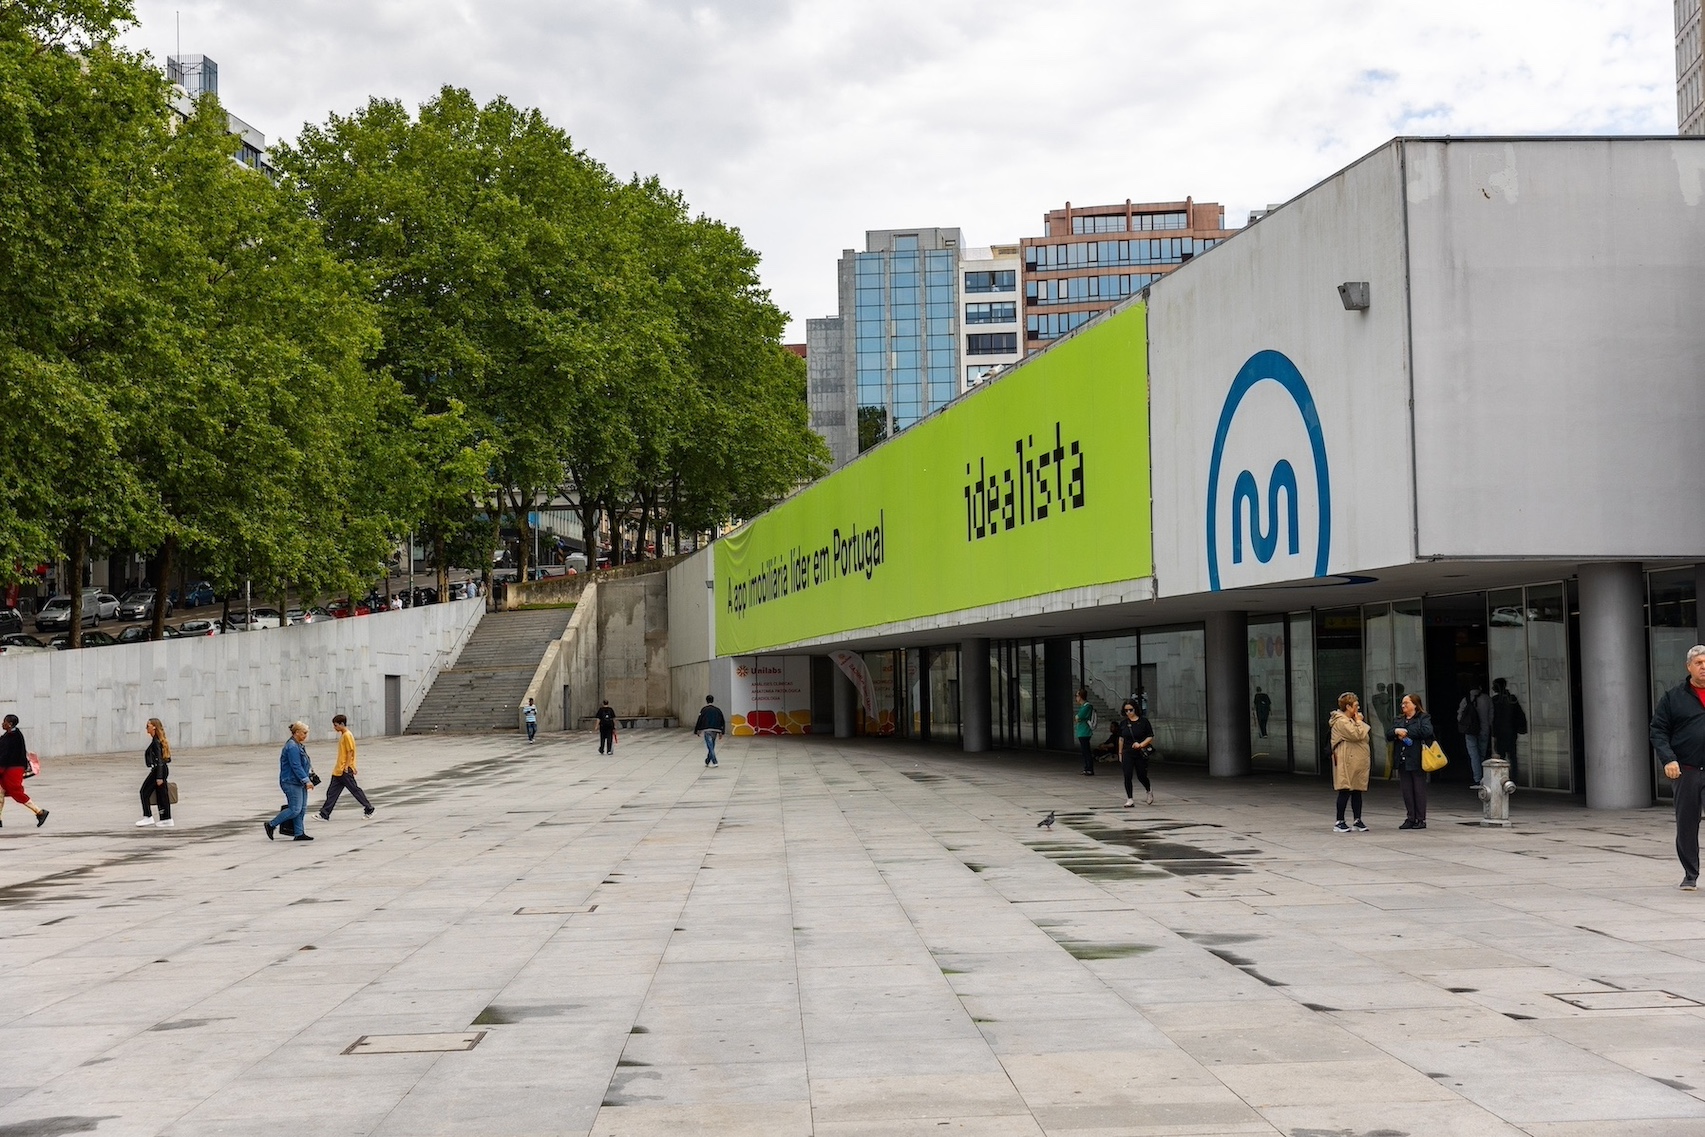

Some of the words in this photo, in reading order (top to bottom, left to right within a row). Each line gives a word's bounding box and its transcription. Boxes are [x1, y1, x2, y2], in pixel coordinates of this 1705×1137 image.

[964, 421, 1085, 542] idealista
[727, 576, 734, 614] A
[733, 580, 748, 620] app
[748, 554, 789, 608] imobiliária
[790, 545, 811, 594] líder
[813, 545, 830, 586] em
[832, 509, 885, 581] Portugal
[750, 666, 783, 675] Unilabs
